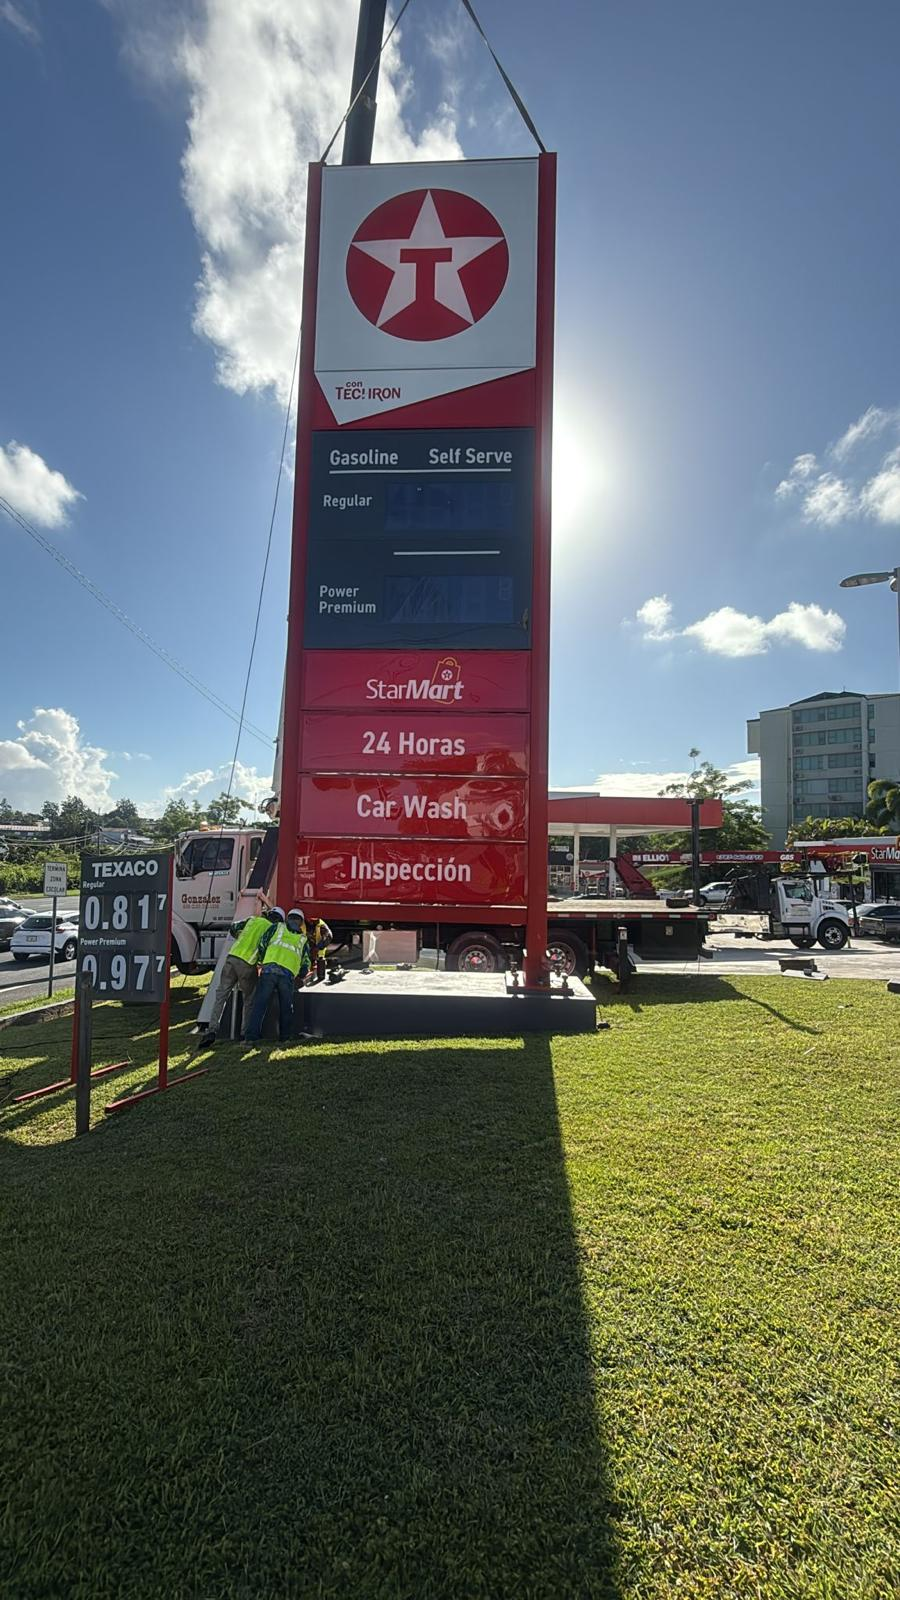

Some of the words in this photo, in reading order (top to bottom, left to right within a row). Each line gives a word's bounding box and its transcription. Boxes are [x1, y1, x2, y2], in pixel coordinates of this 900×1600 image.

[329, 449, 399, 465] Gasoline
[428, 448, 461, 464] Self
[465, 449, 512, 464] Serve
[323, 494, 372, 510] Regular
[319, 585, 359, 598] Power
[319, 601, 376, 614] Premium
[366, 679, 464, 700] StarMart
[362, 731, 391, 754] 24
[399, 732, 466, 756] Horas
[356, 794, 399, 818] Car
[403, 795, 467, 819] Wash
[92, 860, 159, 878] TEXACO
[351, 855, 471, 886] Inspección
[82, 881, 105, 890] Regular
[80, 938, 99, 946] Power
[99, 938, 127, 946] Premium
